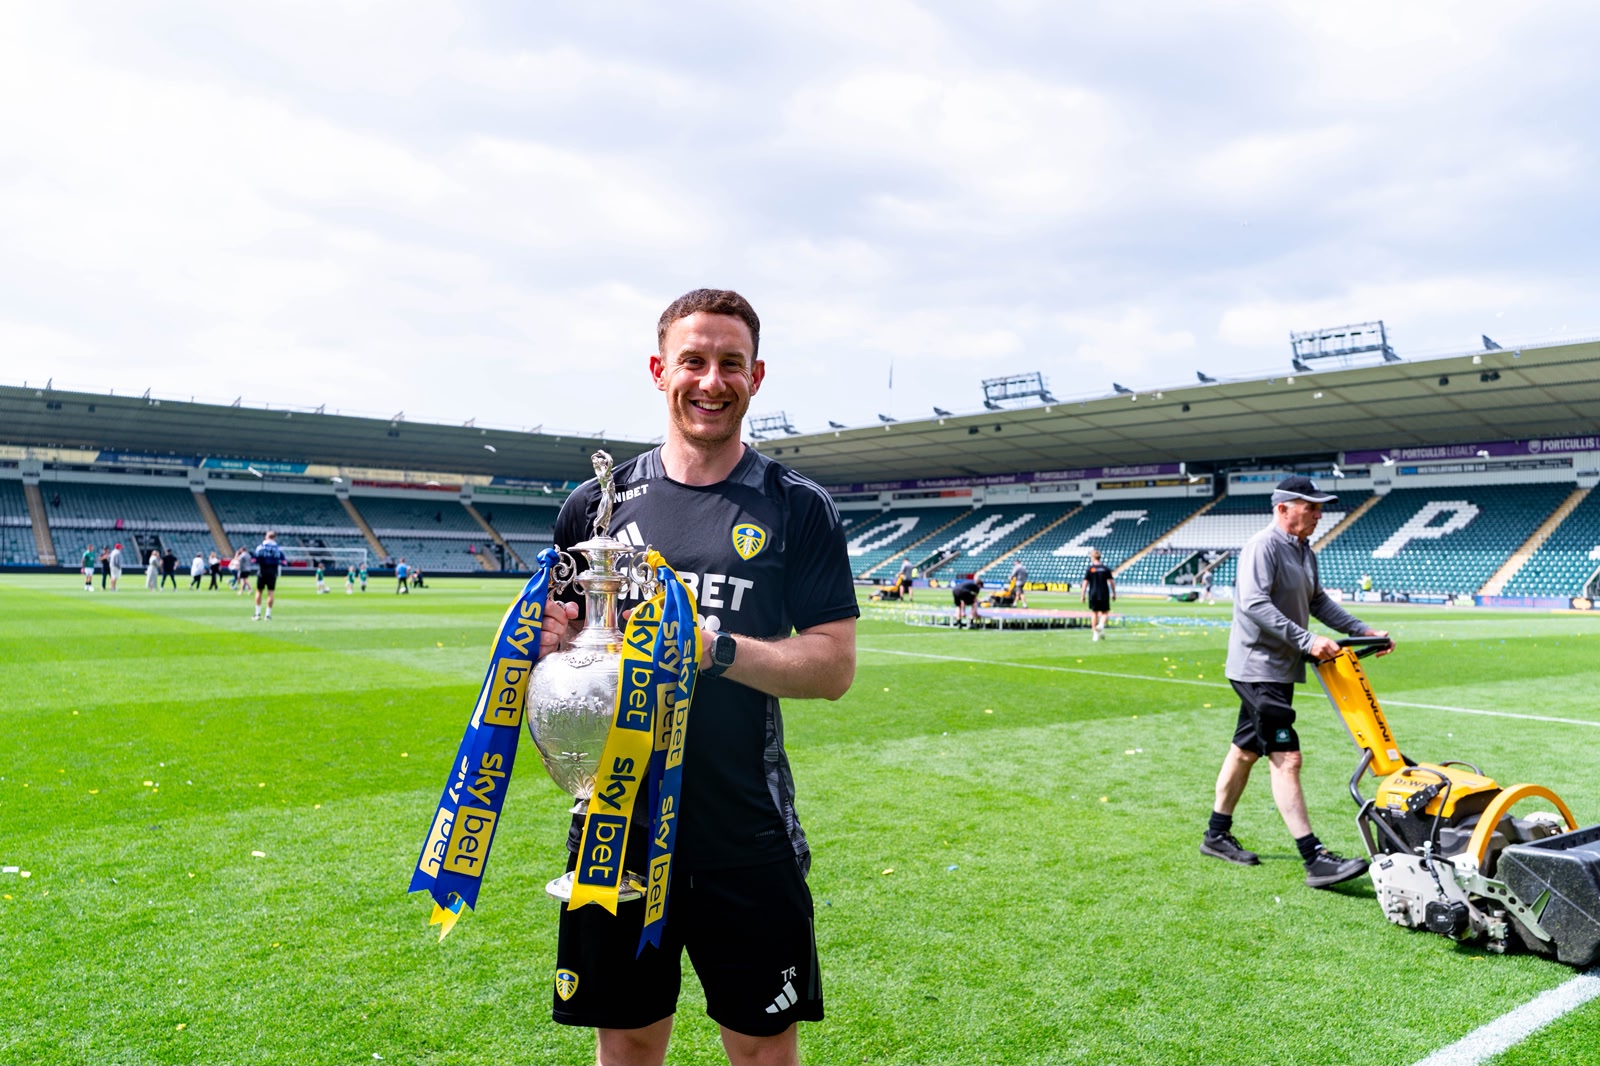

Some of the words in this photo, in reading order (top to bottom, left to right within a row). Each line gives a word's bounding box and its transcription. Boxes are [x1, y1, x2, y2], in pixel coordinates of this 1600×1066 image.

[1401, 448, 1446, 459] PORTCULLIS
[1542, 439, 1595, 451] PORTCULLIS
[613, 484, 649, 503] NIBET
[507, 600, 543, 656] sky
[627, 603, 660, 657] sky
[494, 665, 528, 719] bet
[678, 639, 693, 694] sky
[626, 666, 654, 724] bet
[670, 706, 688, 763] bet
[466, 752, 506, 806] sky
[597, 756, 637, 811] sky
[454, 814, 492, 868] bet
[654, 795, 675, 850] sky
[588, 821, 623, 879] bet
[648, 861, 668, 919] bet
[781, 965, 797, 983] TR
